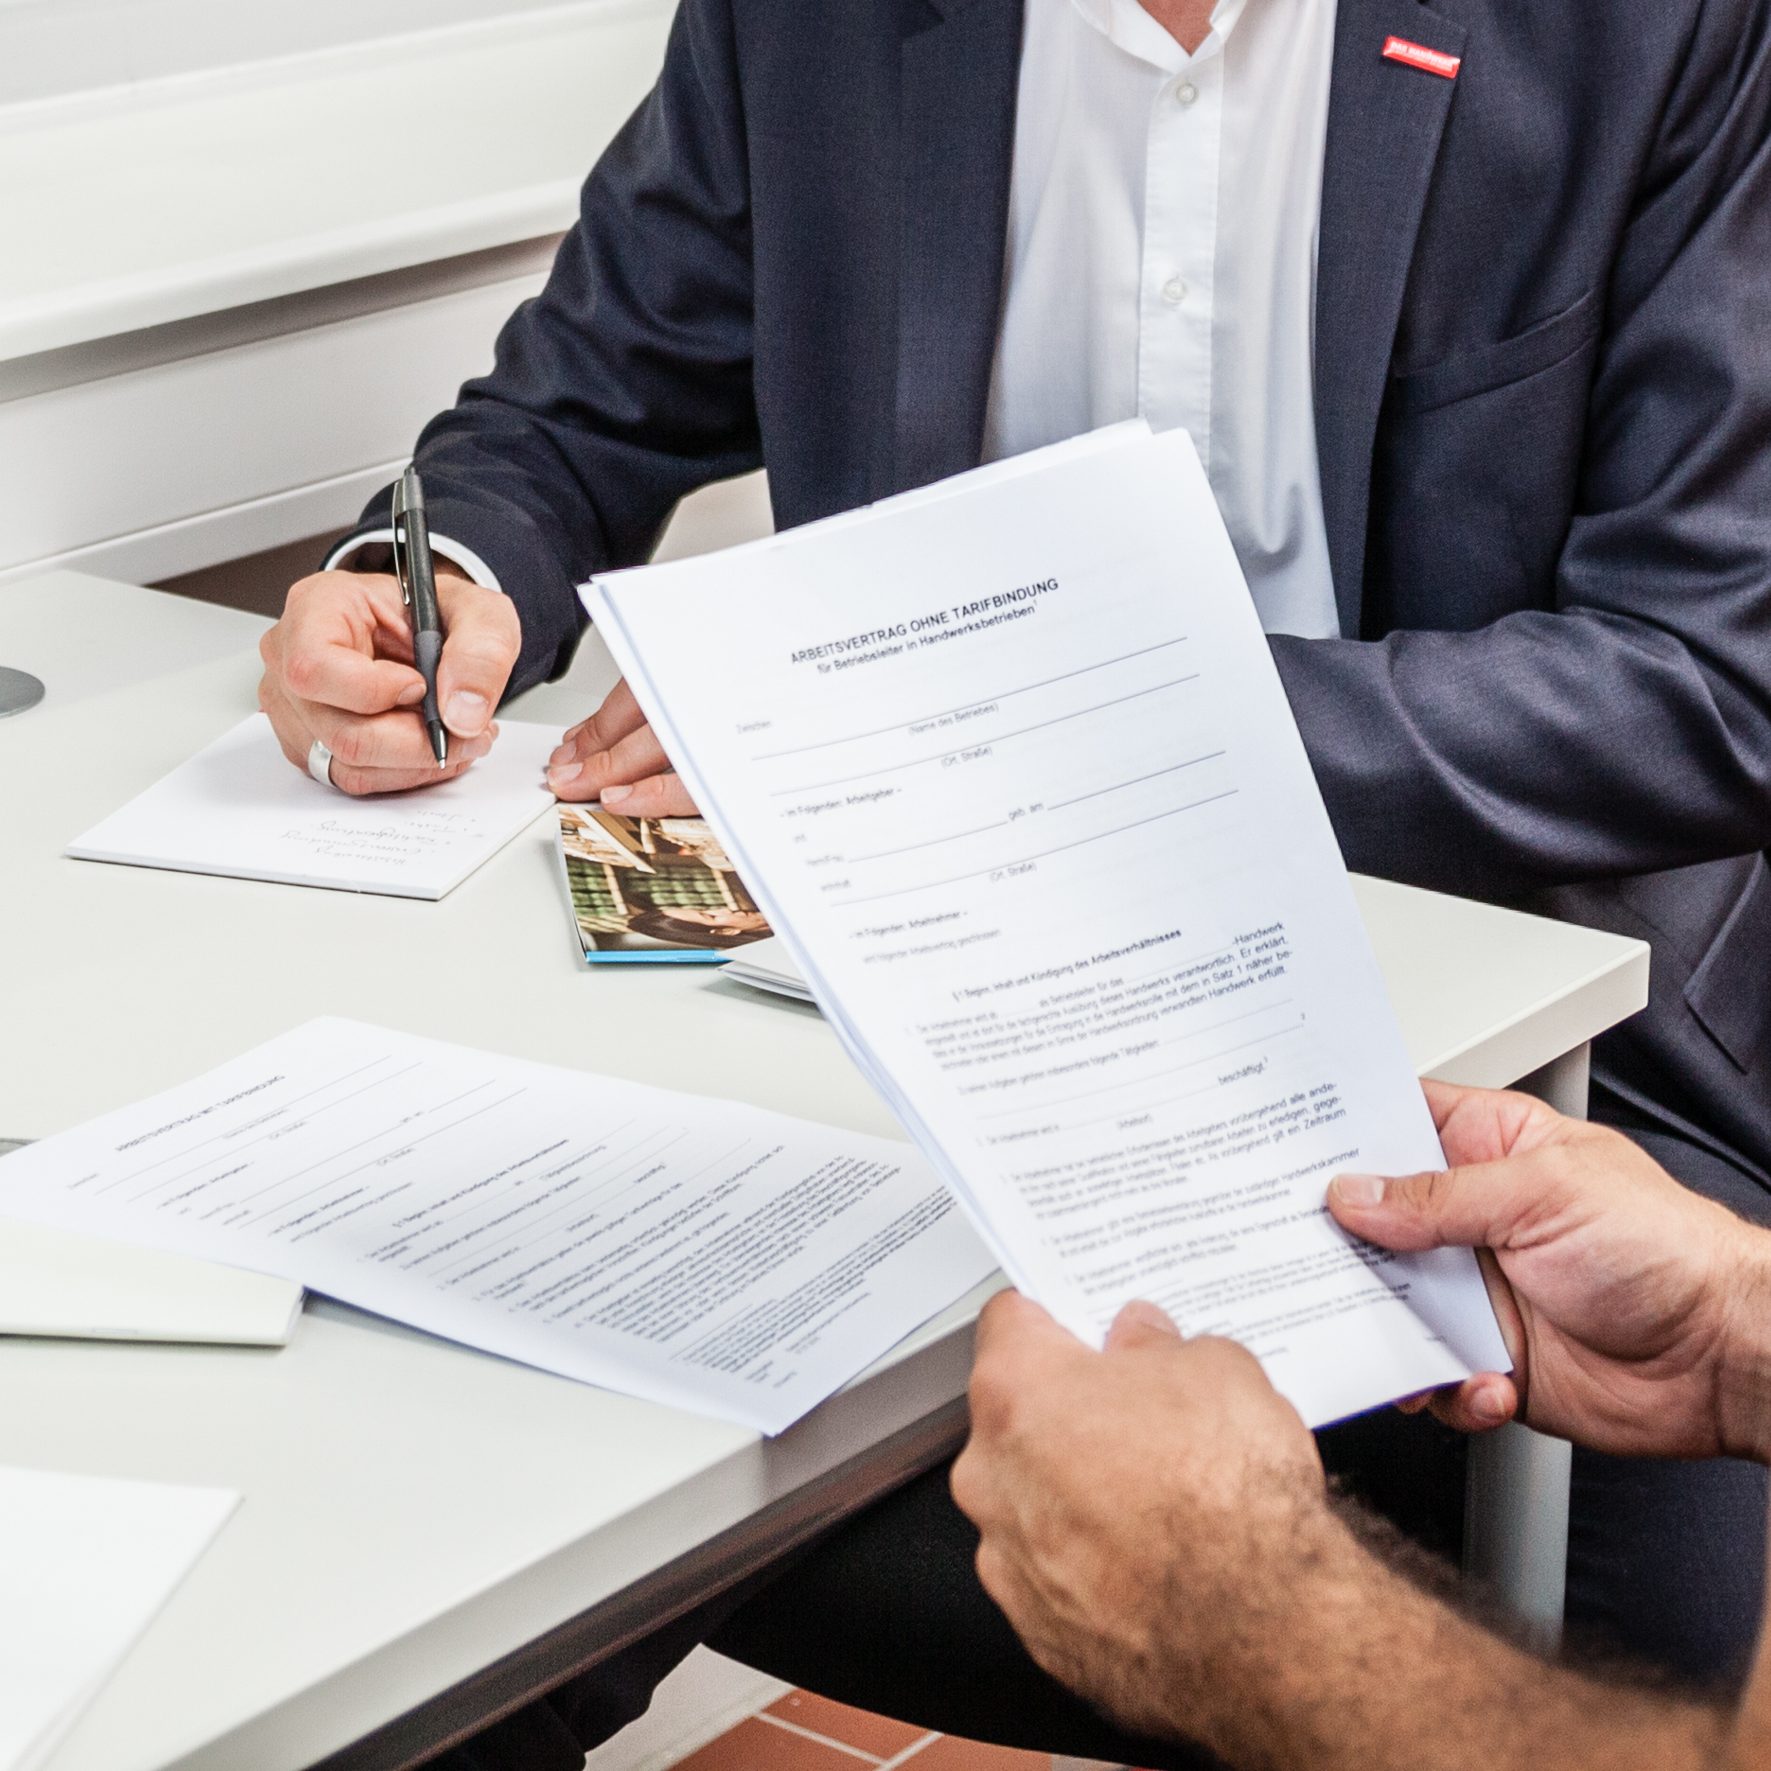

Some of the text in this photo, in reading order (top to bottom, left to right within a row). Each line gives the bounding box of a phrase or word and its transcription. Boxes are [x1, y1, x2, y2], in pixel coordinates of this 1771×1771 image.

[790, 577, 1059, 663] ARBEITSVERTRAG OHNE TARIFBINDUNG
[815, 662, 832, 674] für
[832, 644, 903, 670] Betriebsleiter
[904, 640, 918, 651] in
[953, 703, 999, 722] Betriebes)
[1029, 964, 1074, 981] Kündigung
[1073, 959, 1090, 970] des
[1090, 929, 1182, 964] Arbeitsverhältnisses
[1124, 976, 1171, 995] Handwerks
[1172, 953, 1235, 981] verantwortlich.
[1238, 947, 1251, 959] Er
[1253, 934, 1288, 953] erklärt,
[1179, 980, 1200, 994] dem
[1200, 976, 1211, 986] in
[1211, 968, 1234, 983] Satz
[1244, 954, 1273, 971] näher
[1274, 949, 1293, 961] be-
[1159, 993, 1208, 1015] verwandten
[1207, 975, 1256, 999] Handwerk
[1256, 964, 1285, 982] erfüllt.
[1288, 1092, 1306, 1105] alle
[1308, 1082, 1337, 1098] ande-
[1267, 1106, 1308, 1127] erledigen,
[1312, 1095, 1342, 1113] gege-
[1286, 1124, 1301, 1136] ein
[1303, 1107, 1347, 1130] Zeitraum
[1281, 1147, 1359, 1181] Handwerkskammer
